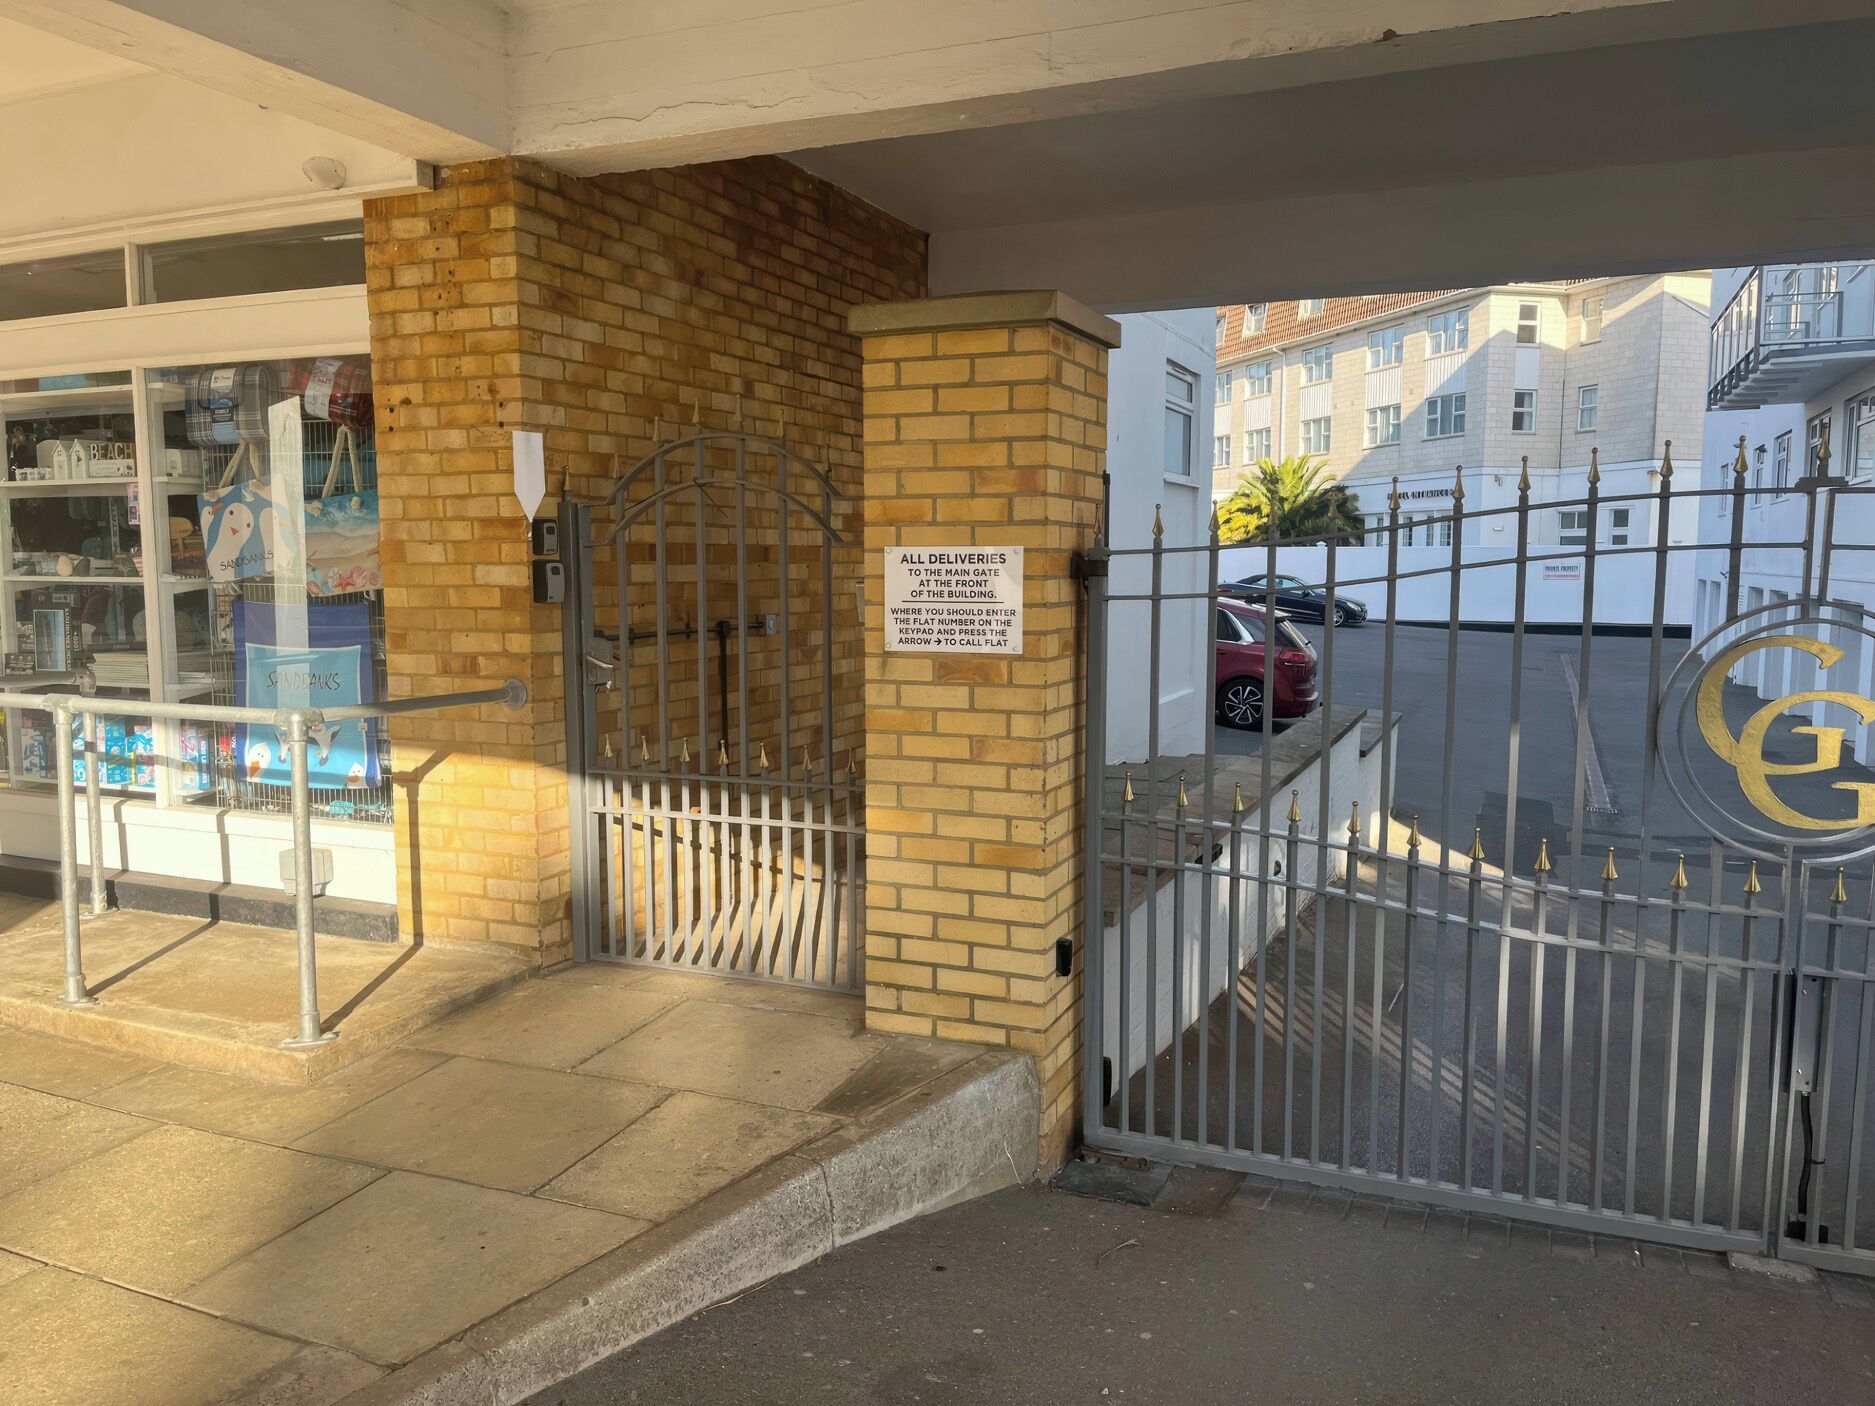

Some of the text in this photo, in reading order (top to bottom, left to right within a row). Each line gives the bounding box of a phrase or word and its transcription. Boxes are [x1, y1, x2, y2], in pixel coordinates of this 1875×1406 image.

[90, 442, 133, 461] BEACH
[220, 550, 273, 571] SANDBANKS
[901, 554, 1006, 564] ALL DELIVERIES
[911, 590, 924, 598] OF
[267, 671, 340, 690] SANDBANKS
